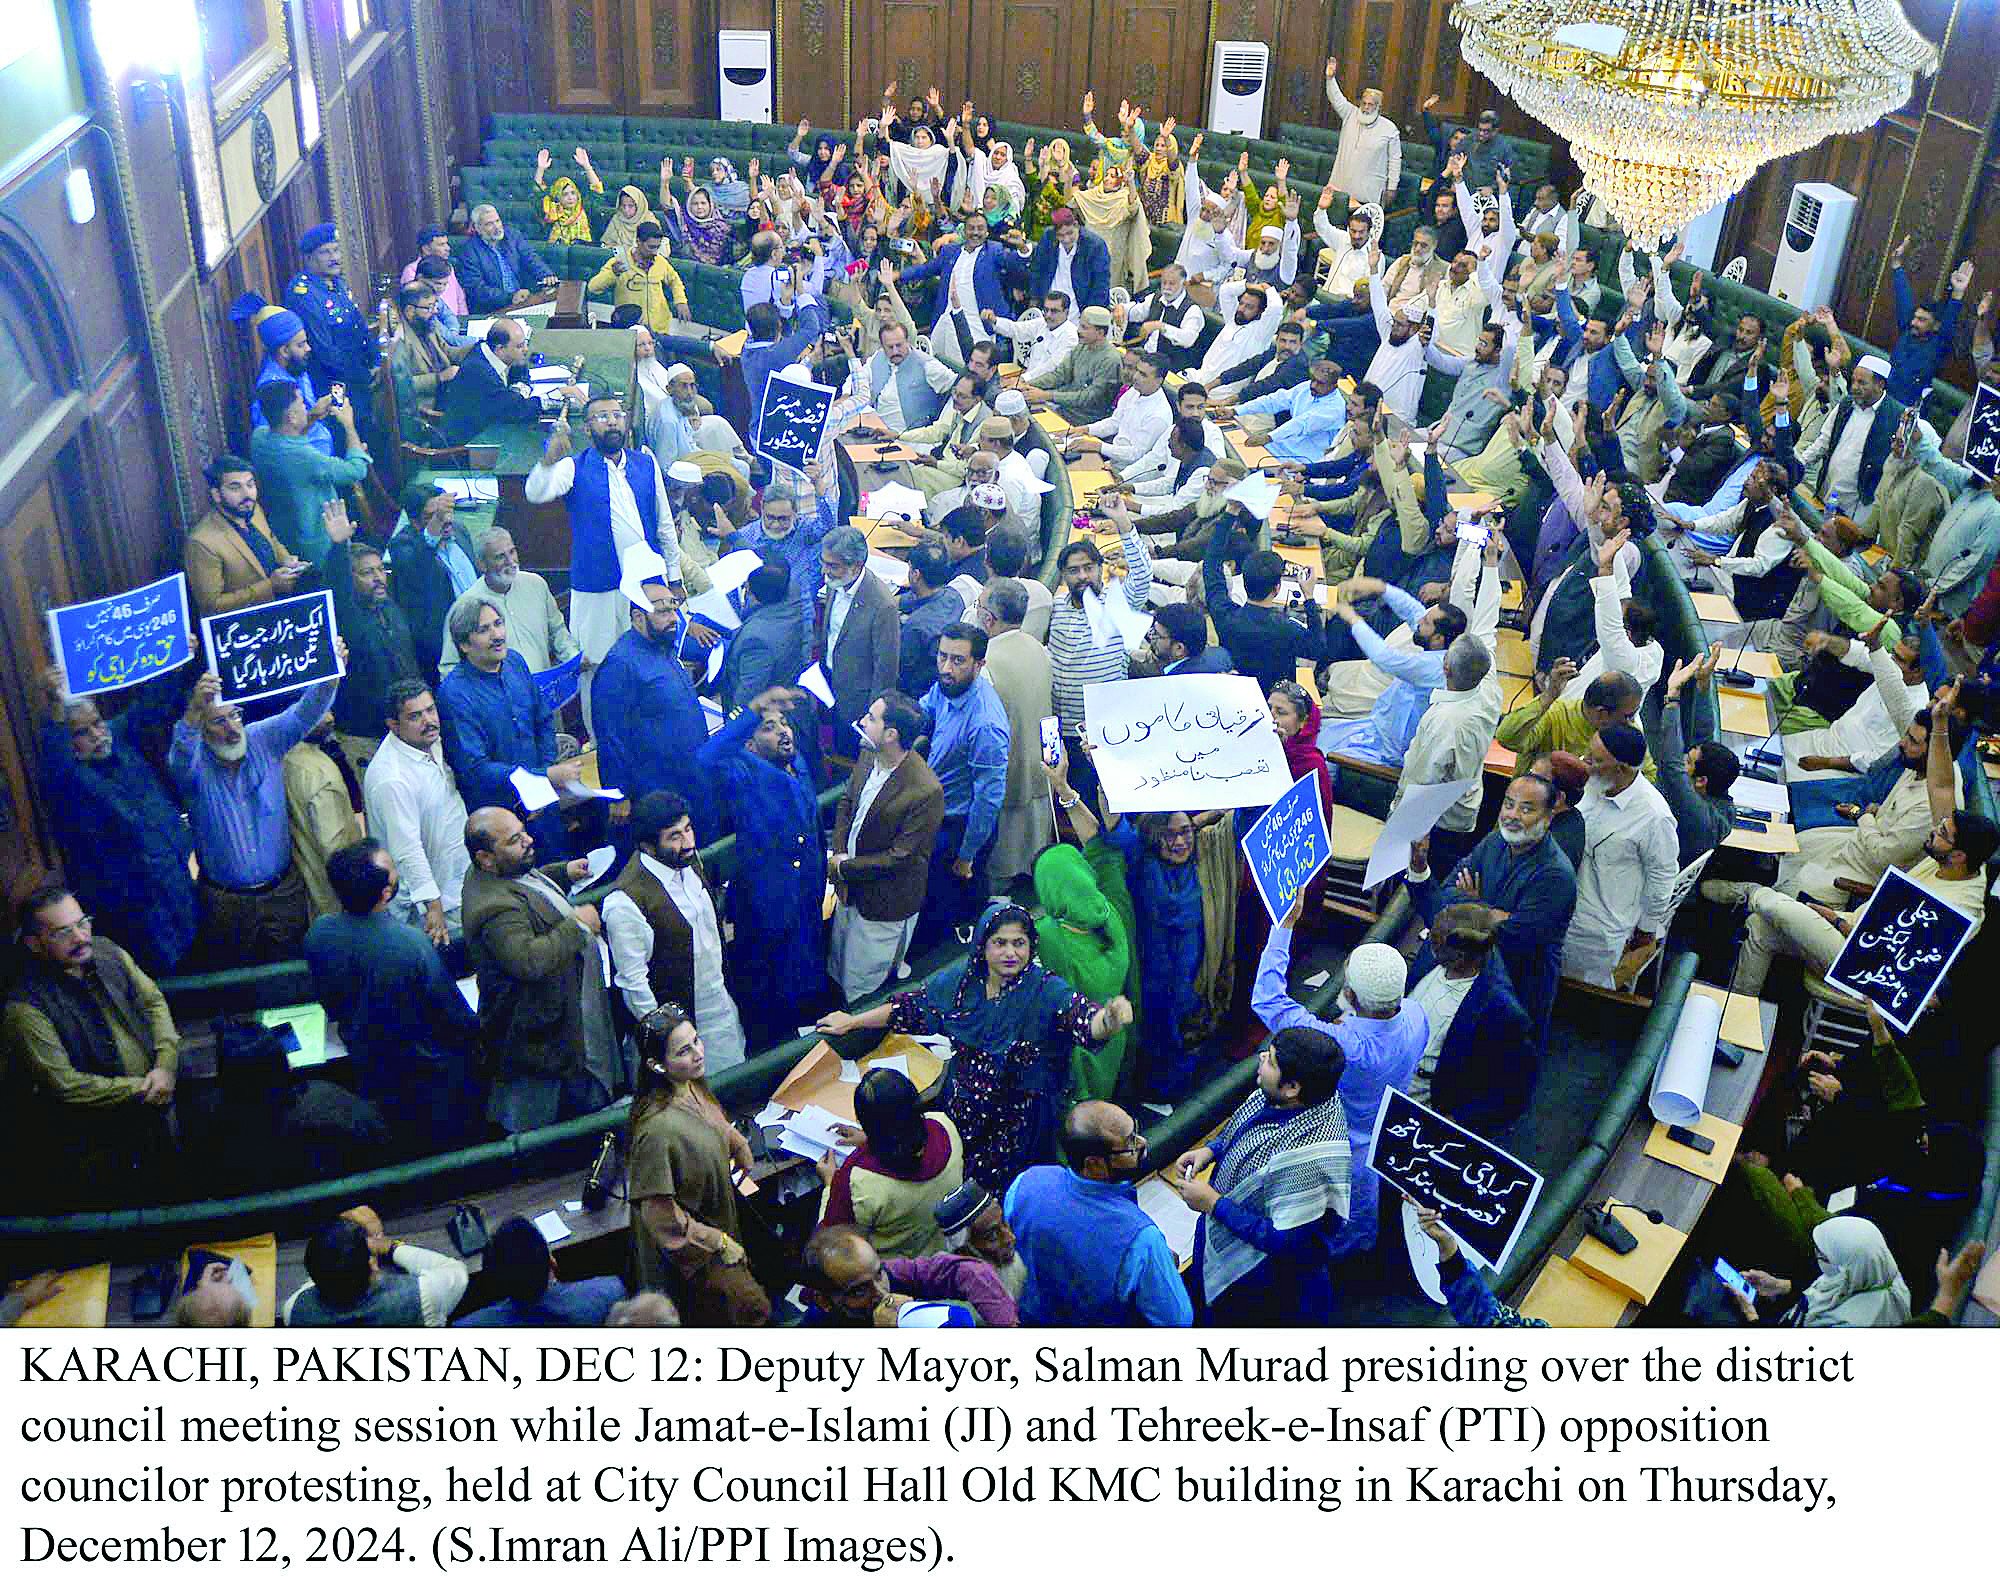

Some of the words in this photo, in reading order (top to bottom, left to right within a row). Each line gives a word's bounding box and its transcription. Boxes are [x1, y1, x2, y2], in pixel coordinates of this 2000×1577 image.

[112, 603, 132, 619] 46
[152, 609, 176, 630] 246
[295, 604, 323, 637] ایک
[216, 622, 240, 658] گیا
[233, 627, 268, 649] جیت
[270, 618, 294, 643] ہزار
[268, 653, 293, 679] ہزار
[294, 637, 318, 672] تین
[232, 653, 256, 688] گیا
[250, 658, 268, 686] ہار
[1175, 746, 1220, 763] میں
[1205, 759, 1271, 783] تعصب
[1272, 811, 1284, 832] 46
[1296, 807, 1314, 834] 246
[1897, 900, 1938, 928] جعلی
[1896, 947, 1942, 972] ضمنی
[1385, 1117, 1435, 1150] ساتھ
[1386, 1155, 1430, 1172] کرو
[1427, 1142, 1467, 1171] کے
[1405, 1170, 1434, 1195] بند
[1462, 1162, 1529, 1197] کراچی
[1432, 1186, 1507, 1226] تعصب
